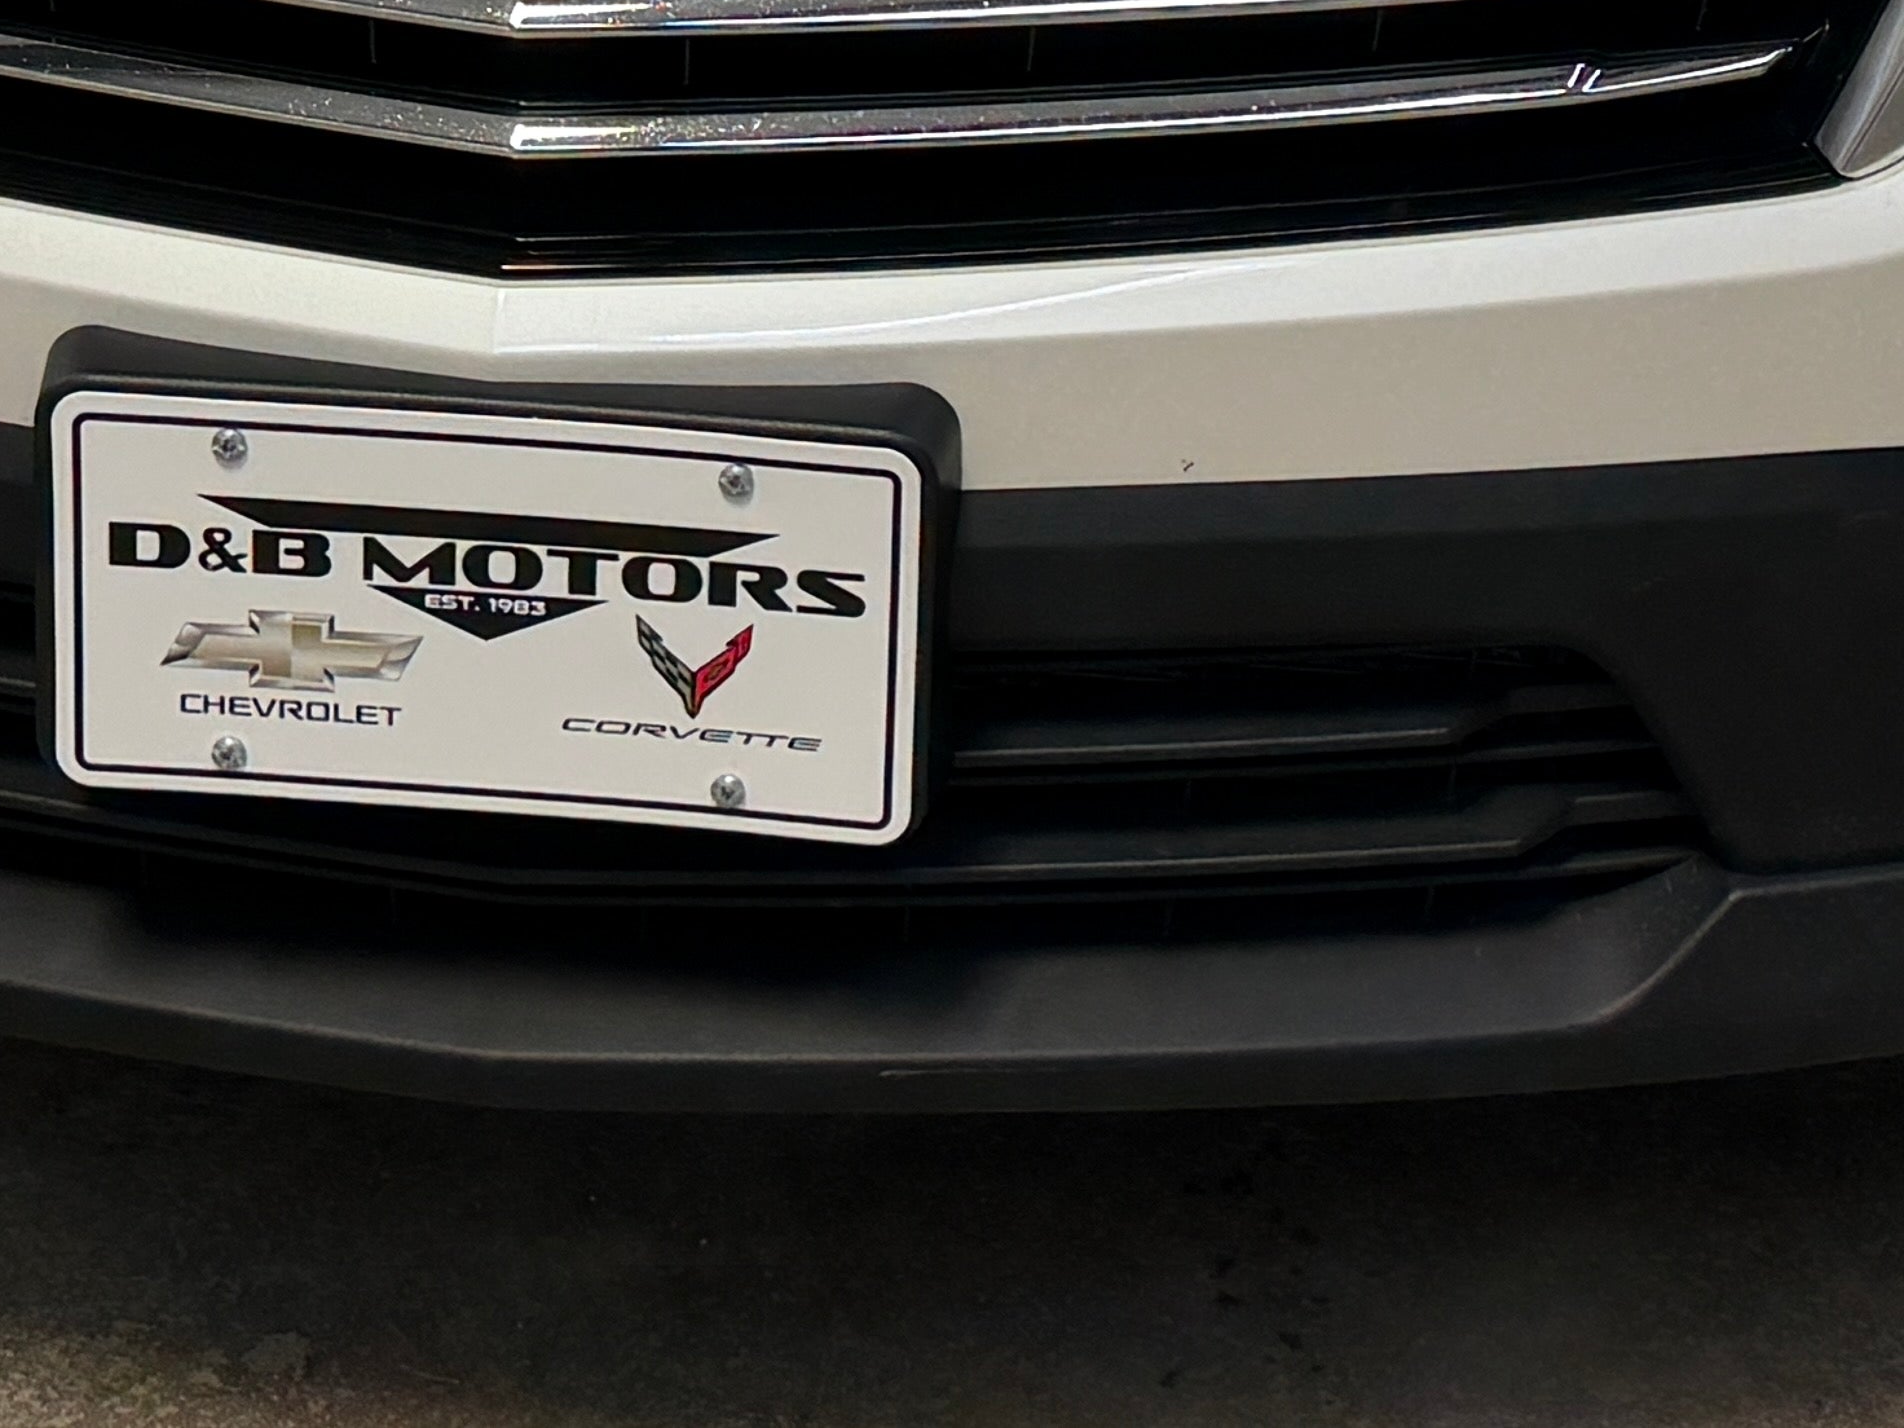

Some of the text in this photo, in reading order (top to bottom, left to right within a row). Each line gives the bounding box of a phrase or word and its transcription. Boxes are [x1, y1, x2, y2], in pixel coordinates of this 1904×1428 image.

[108, 521, 867, 618] D&B MOTORS
[424, 593, 547, 617] EST. 1983
[180, 693, 402, 727] CHEVROLET
[561, 717, 823, 752] CORVETTE
